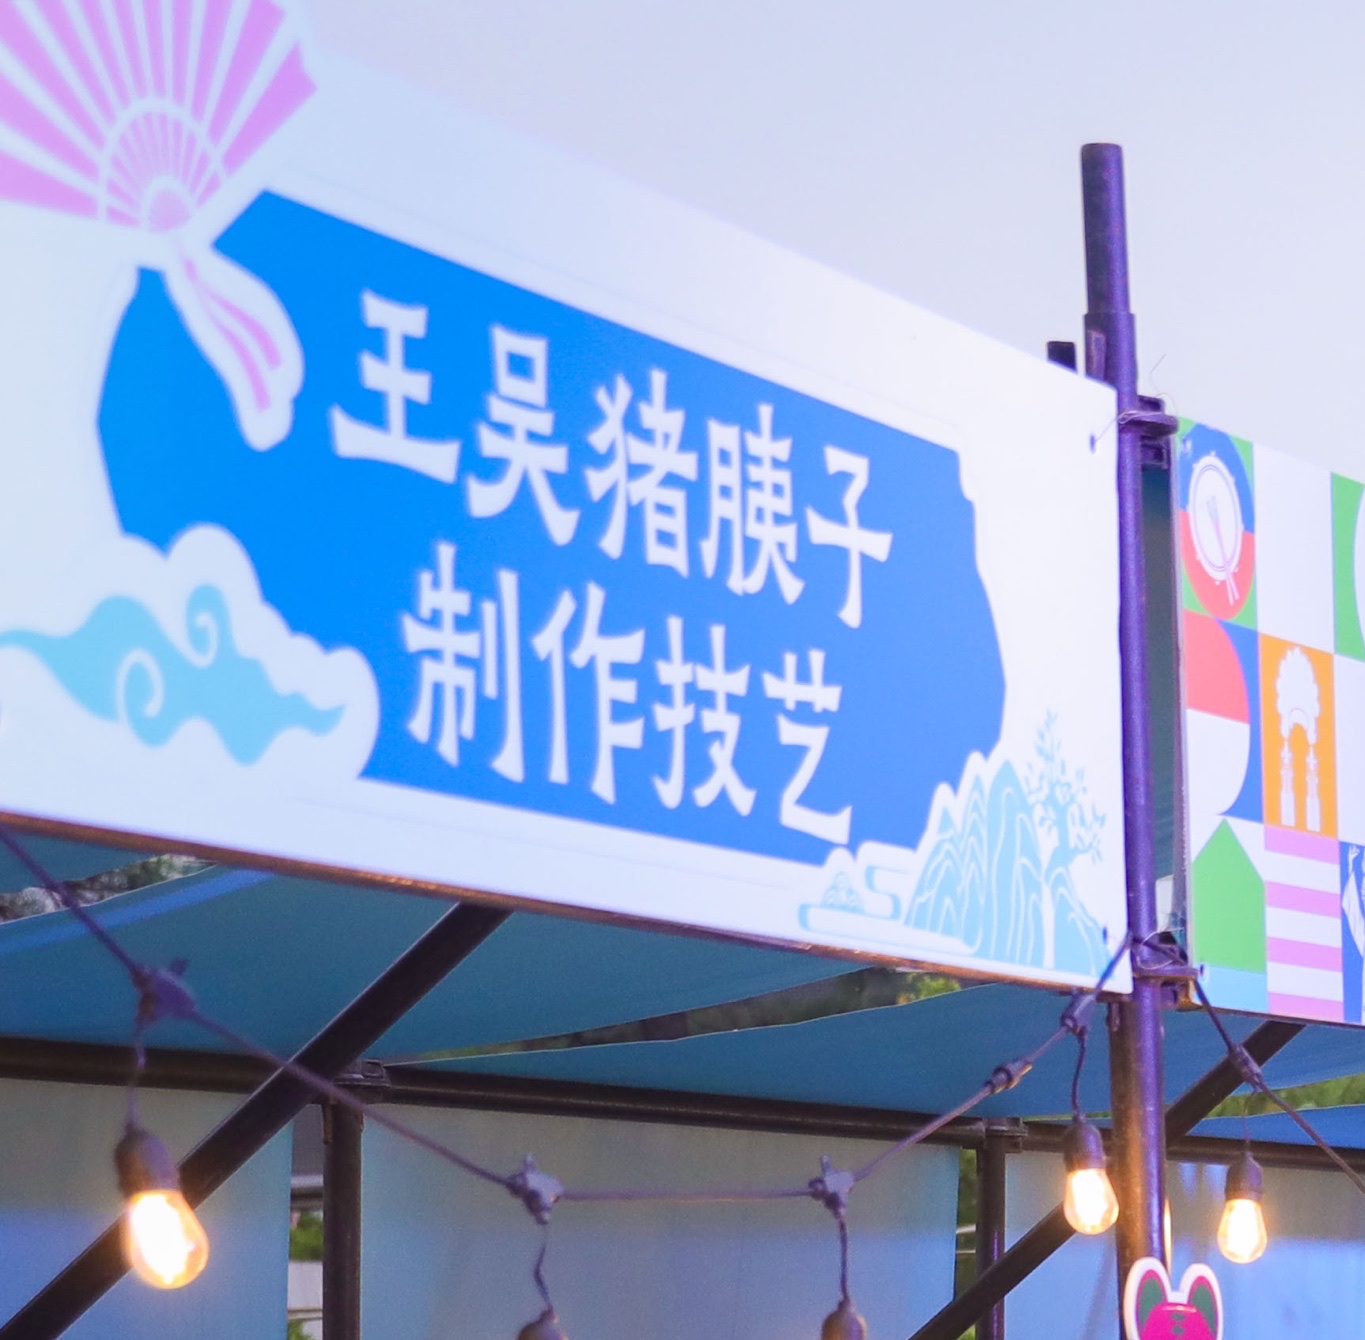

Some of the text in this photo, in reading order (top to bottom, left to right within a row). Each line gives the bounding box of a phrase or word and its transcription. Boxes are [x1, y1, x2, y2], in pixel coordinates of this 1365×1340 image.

[328, 288, 893, 629] 王吴猪胰子
[402, 539, 853, 847] 制作技艺
